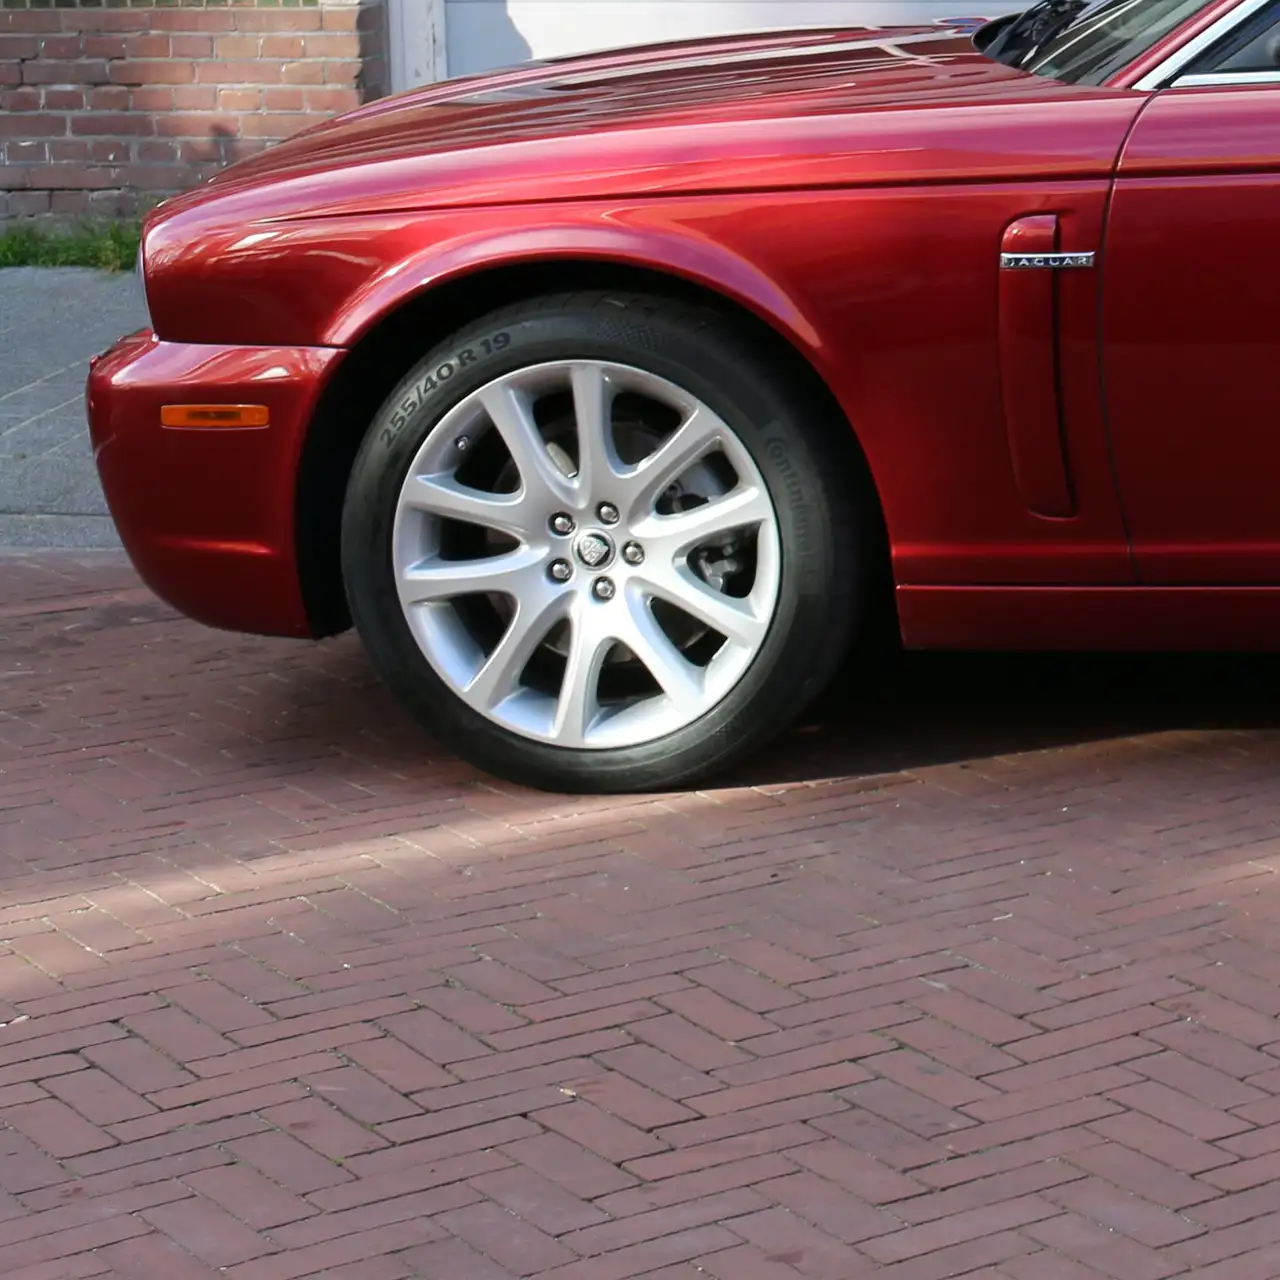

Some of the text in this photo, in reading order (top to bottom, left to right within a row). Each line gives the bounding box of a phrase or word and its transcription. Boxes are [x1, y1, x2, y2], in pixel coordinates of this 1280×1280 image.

[1006, 257, 1088, 267] JAGUAR
[381, 332, 511, 449] 255/40 R 19
